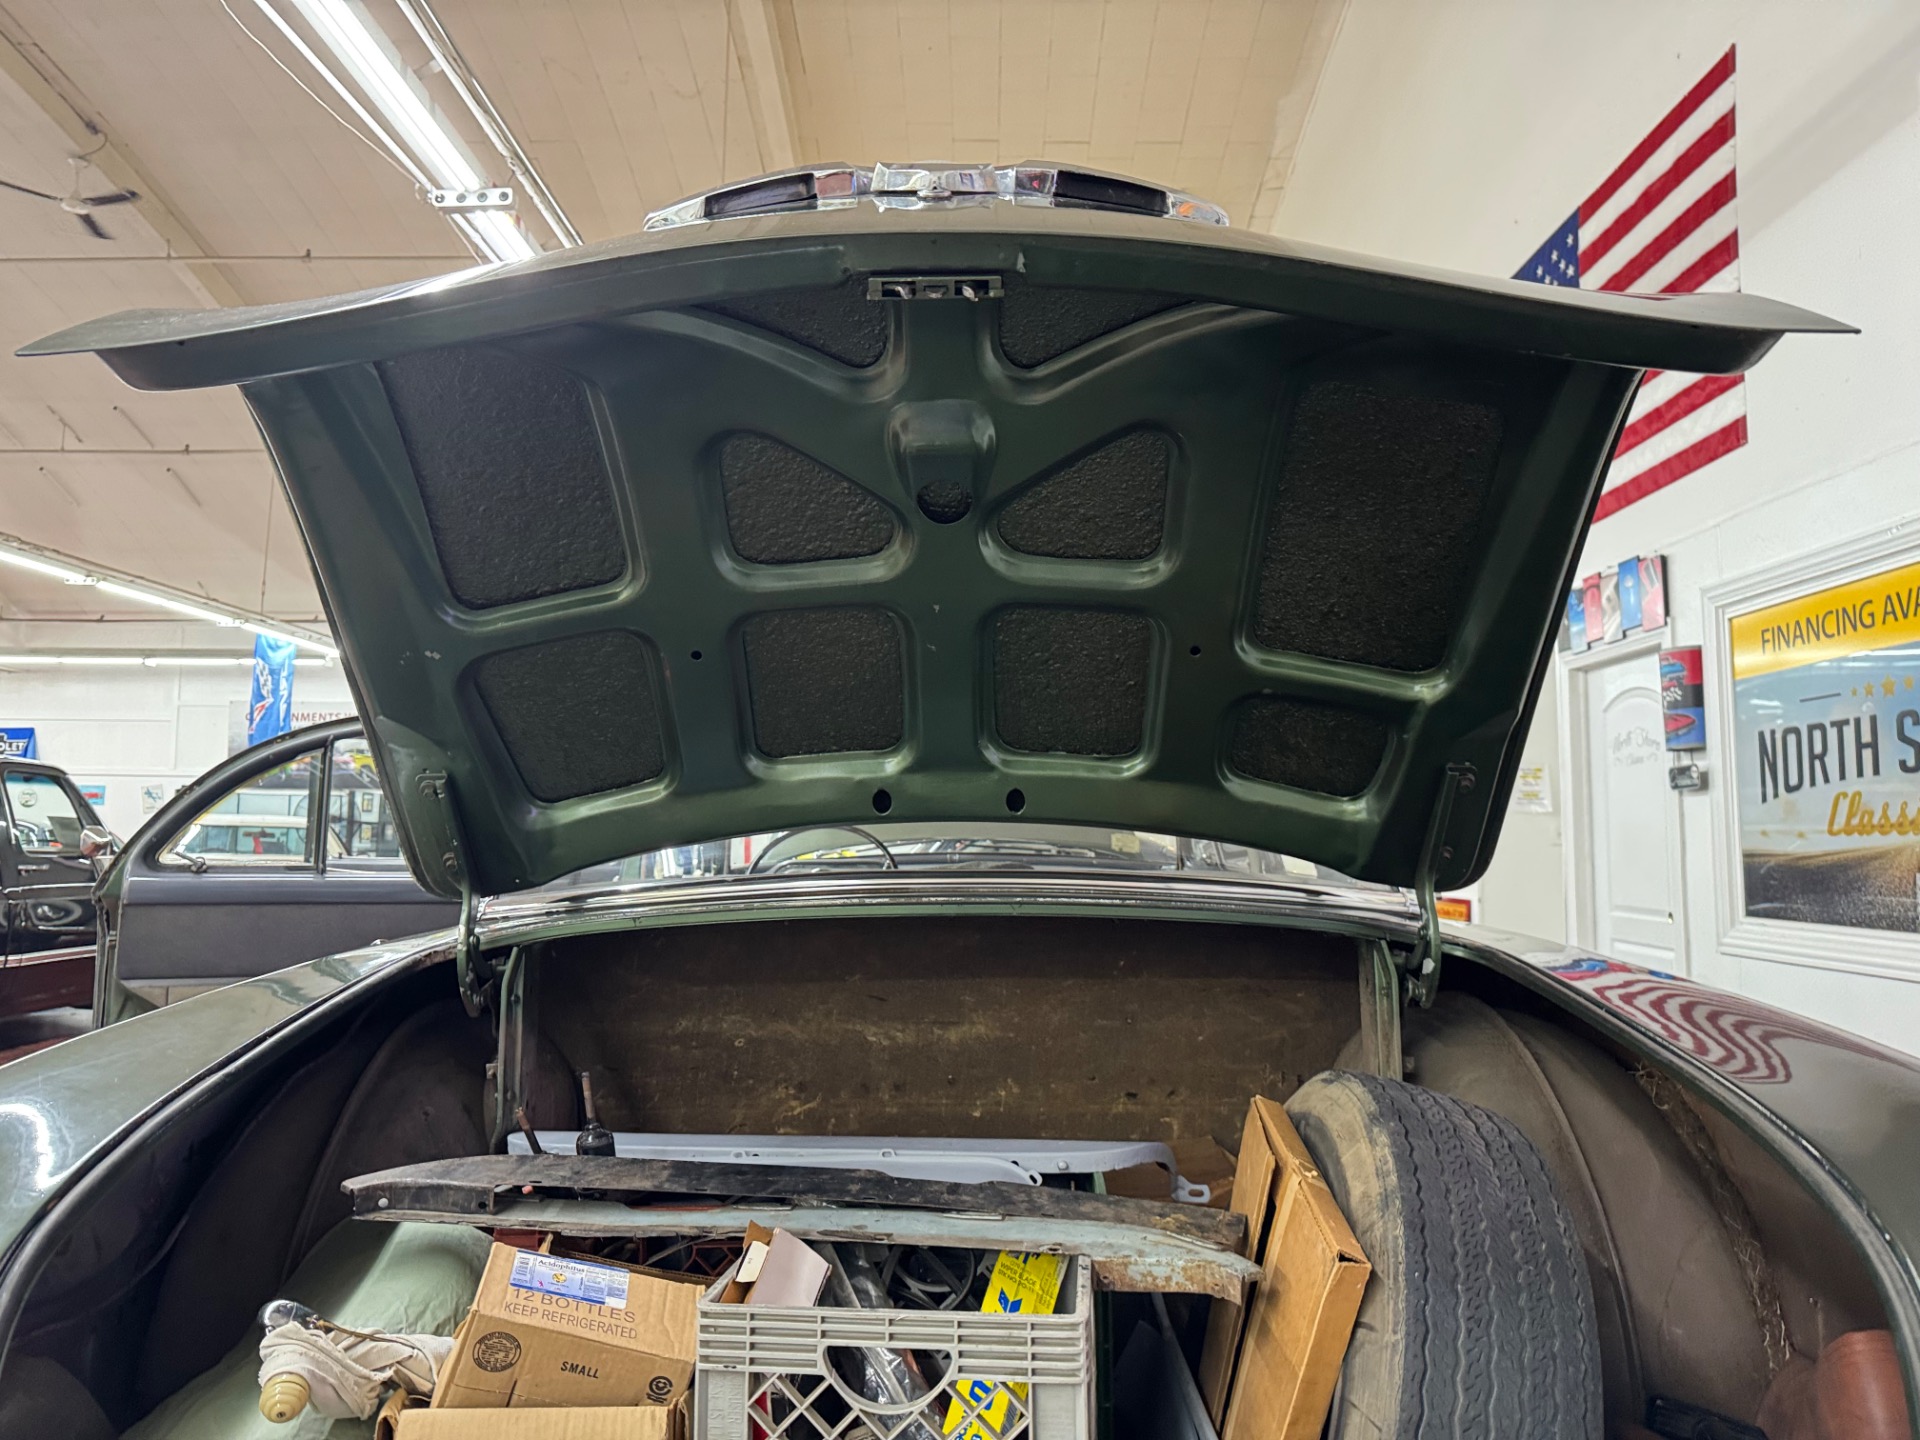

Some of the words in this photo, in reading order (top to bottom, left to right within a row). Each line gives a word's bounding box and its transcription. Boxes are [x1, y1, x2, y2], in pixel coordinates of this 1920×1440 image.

[1761, 599, 1876, 654] FINANCING
[1758, 714, 1880, 804] NORTH
[538, 1259, 585, 1273] Acidophilus
[504, 1301, 539, 1317] KEEP
[542, 1309, 638, 1340] REFRIGERATED
[513, 1288, 535, 1302] 12
[541, 1294, 636, 1323] BOTTLES
[561, 1361, 600, 1379] SMALL
